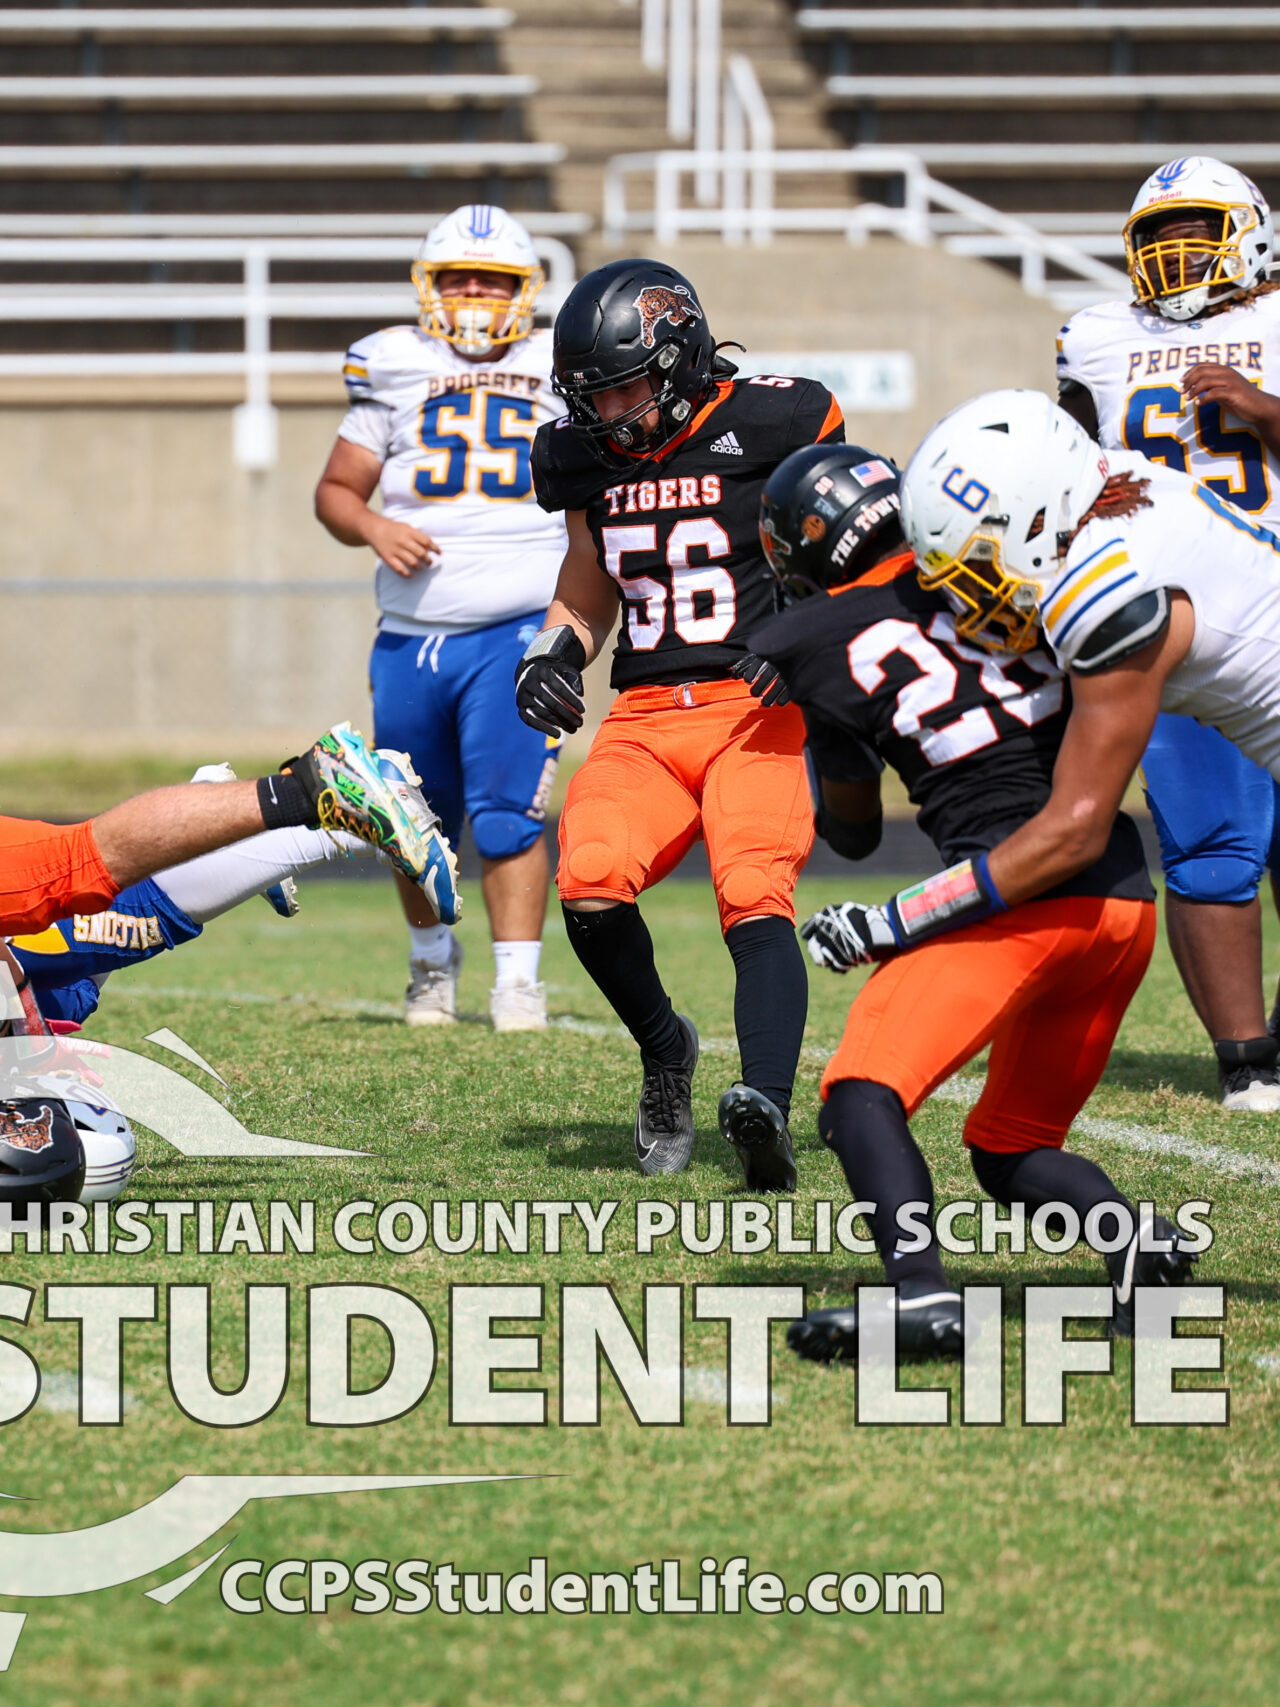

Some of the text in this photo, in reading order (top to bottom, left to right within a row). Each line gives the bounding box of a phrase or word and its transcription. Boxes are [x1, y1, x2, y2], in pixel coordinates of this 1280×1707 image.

[1148, 191, 1183, 204] Riddell
[1126, 341, 1264, 384] PROSSER
[411, 388, 539, 502] 55
[710, 444, 744, 456] adidas
[604, 474, 723, 516] TIGERS
[942, 466, 991, 514] 6
[831, 529, 860, 567] THE
[601, 516, 738, 652] 56
[73, 910, 164, 950] FALCONS
